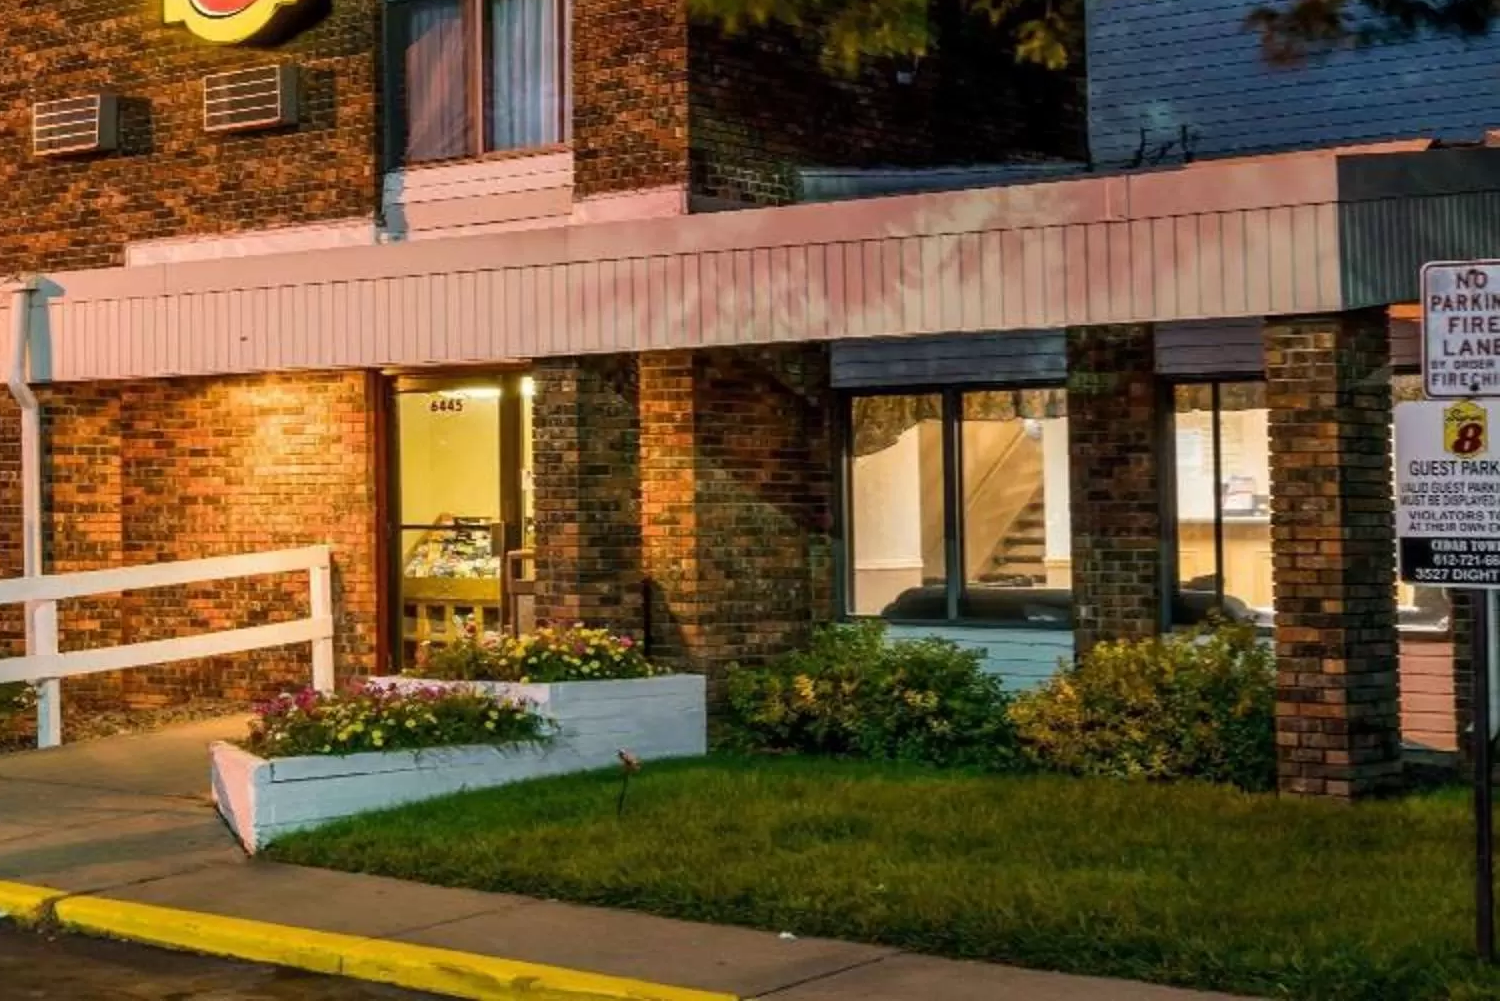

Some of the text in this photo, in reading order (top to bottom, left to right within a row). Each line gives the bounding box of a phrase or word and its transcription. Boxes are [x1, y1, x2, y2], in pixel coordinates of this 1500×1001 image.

[1456, 270, 1489, 289] NO
[1447, 315, 1500, 334] FIRE
[1430, 360, 1495, 370] BY ORDER
[430, 399, 463, 412] 6445
[1452, 422, 1484, 454] 8
[1409, 460, 1457, 476] GUEST
[1431, 482, 1465, 493] GUEST
[1428, 495, 1441, 506] BE
[1408, 510, 1485, 521] VIOLATORS
[1408, 522, 1421, 532] AT
[1425, 522, 1457, 532] THEIR
[1415, 568, 1450, 580] 3527
